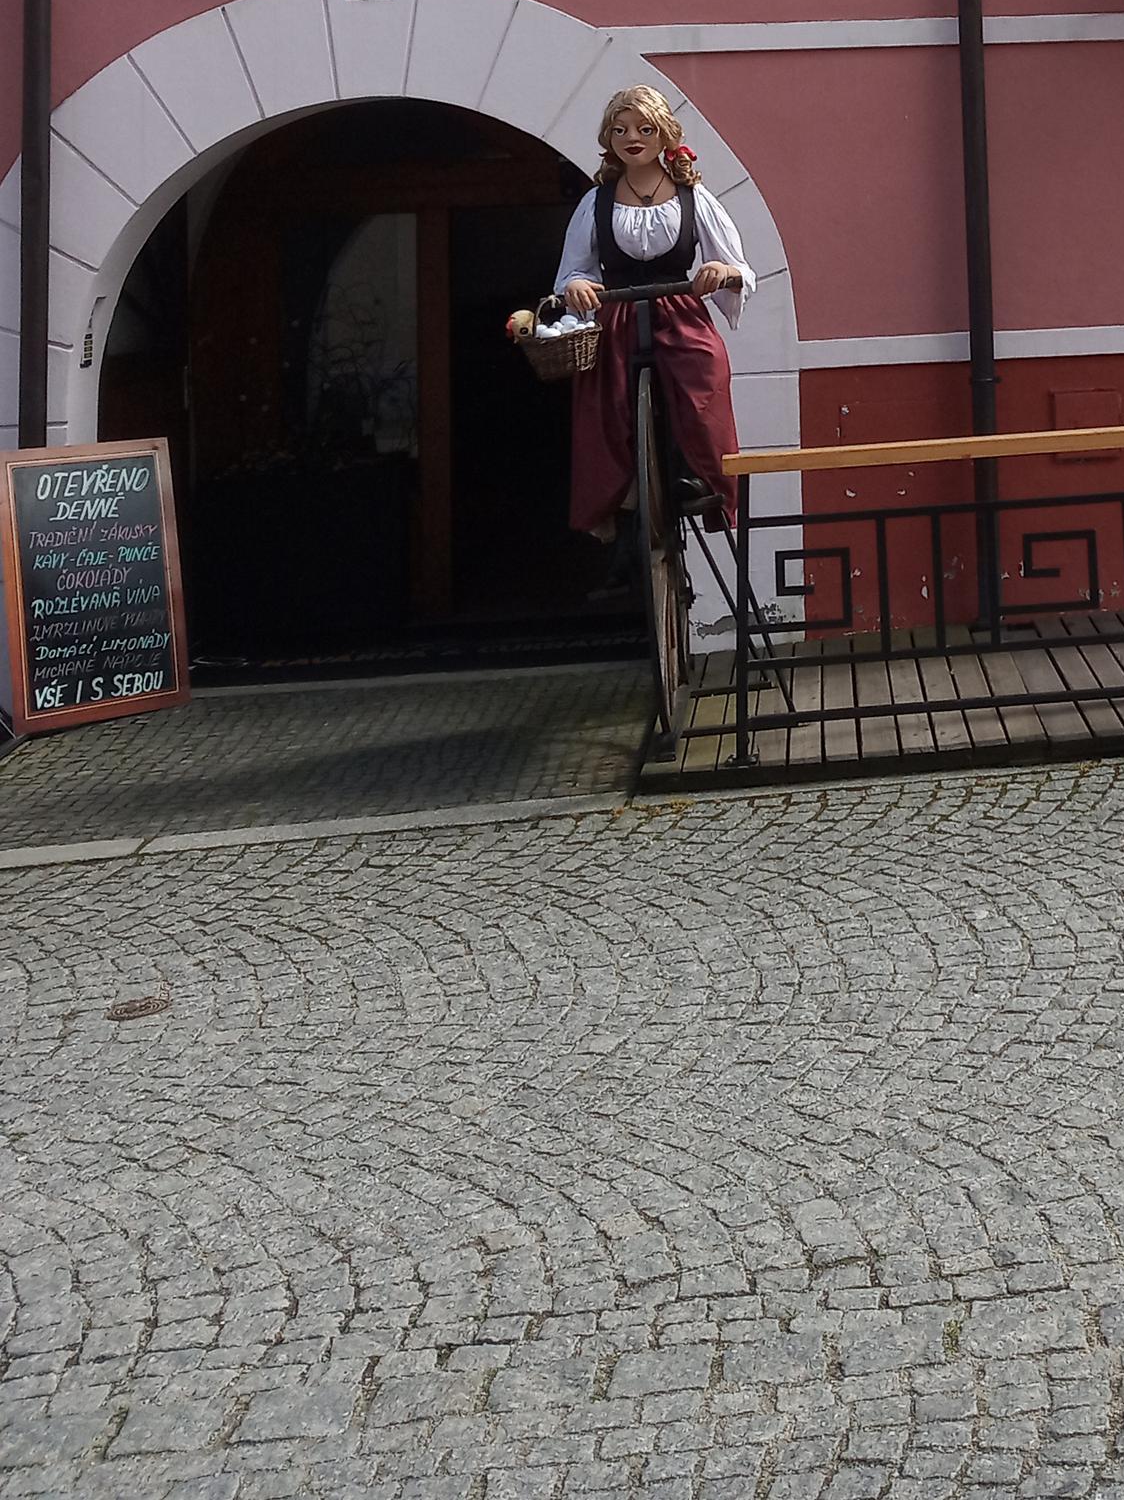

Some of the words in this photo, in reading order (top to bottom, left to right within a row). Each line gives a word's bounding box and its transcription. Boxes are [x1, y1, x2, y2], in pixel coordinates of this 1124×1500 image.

[36, 464, 150, 500] OTEVŘENO
[29, 521, 97, 549] TRADIČNÍ
[100, 522, 158, 542] ZÁKUSKY
[57, 564, 132, 591] ČOKOLÁDY
[127, 578, 160, 604] VÍNA
[34, 679, 68, 709] VŠE
[90, 677, 103, 700] S
[111, 671, 163, 697] SEBOU
